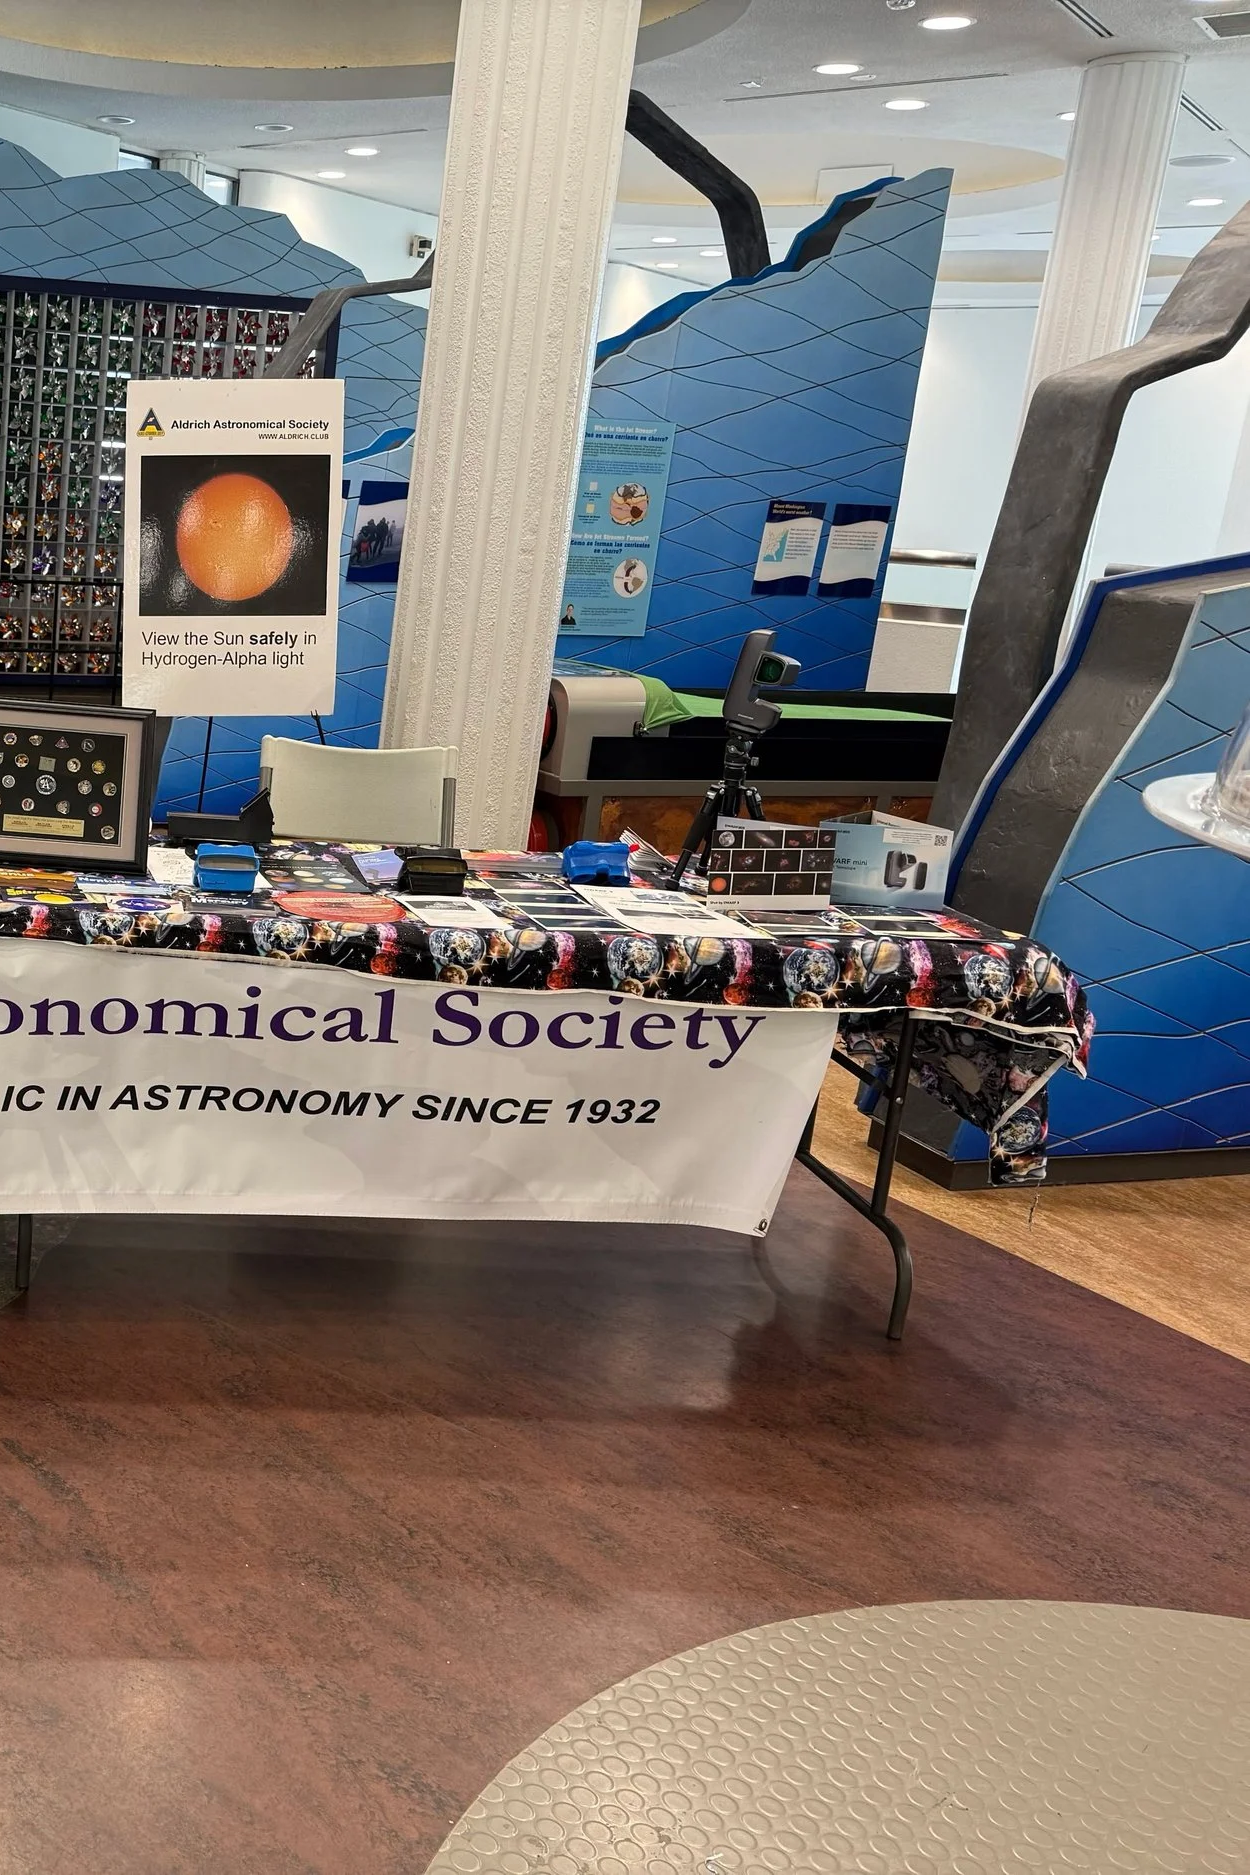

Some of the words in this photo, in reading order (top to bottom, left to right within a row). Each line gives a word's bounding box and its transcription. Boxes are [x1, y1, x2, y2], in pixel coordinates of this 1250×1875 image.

[171, 419, 211, 430] Aldrich
[213, 419, 286, 429] Astronomical
[288, 419, 330, 432] Society
[141, 631, 179, 645] View
[184, 631, 208, 645] the
[213, 631, 244, 645] Sun
[249, 631, 299, 649] safely
[303, 631, 317, 645] in
[141, 651, 267, 669] Hydrogen-Alpha
[272, 651, 304, 669] light
[834, 857, 851, 865] ARF
[432, 988, 766, 1069] Society
[56, 1084, 101, 1111] IN
[109, 1084, 404, 1119] ASTRONOMY
[411, 1093, 555, 1125] SINCE
[564, 1097, 661, 1125] 1932
